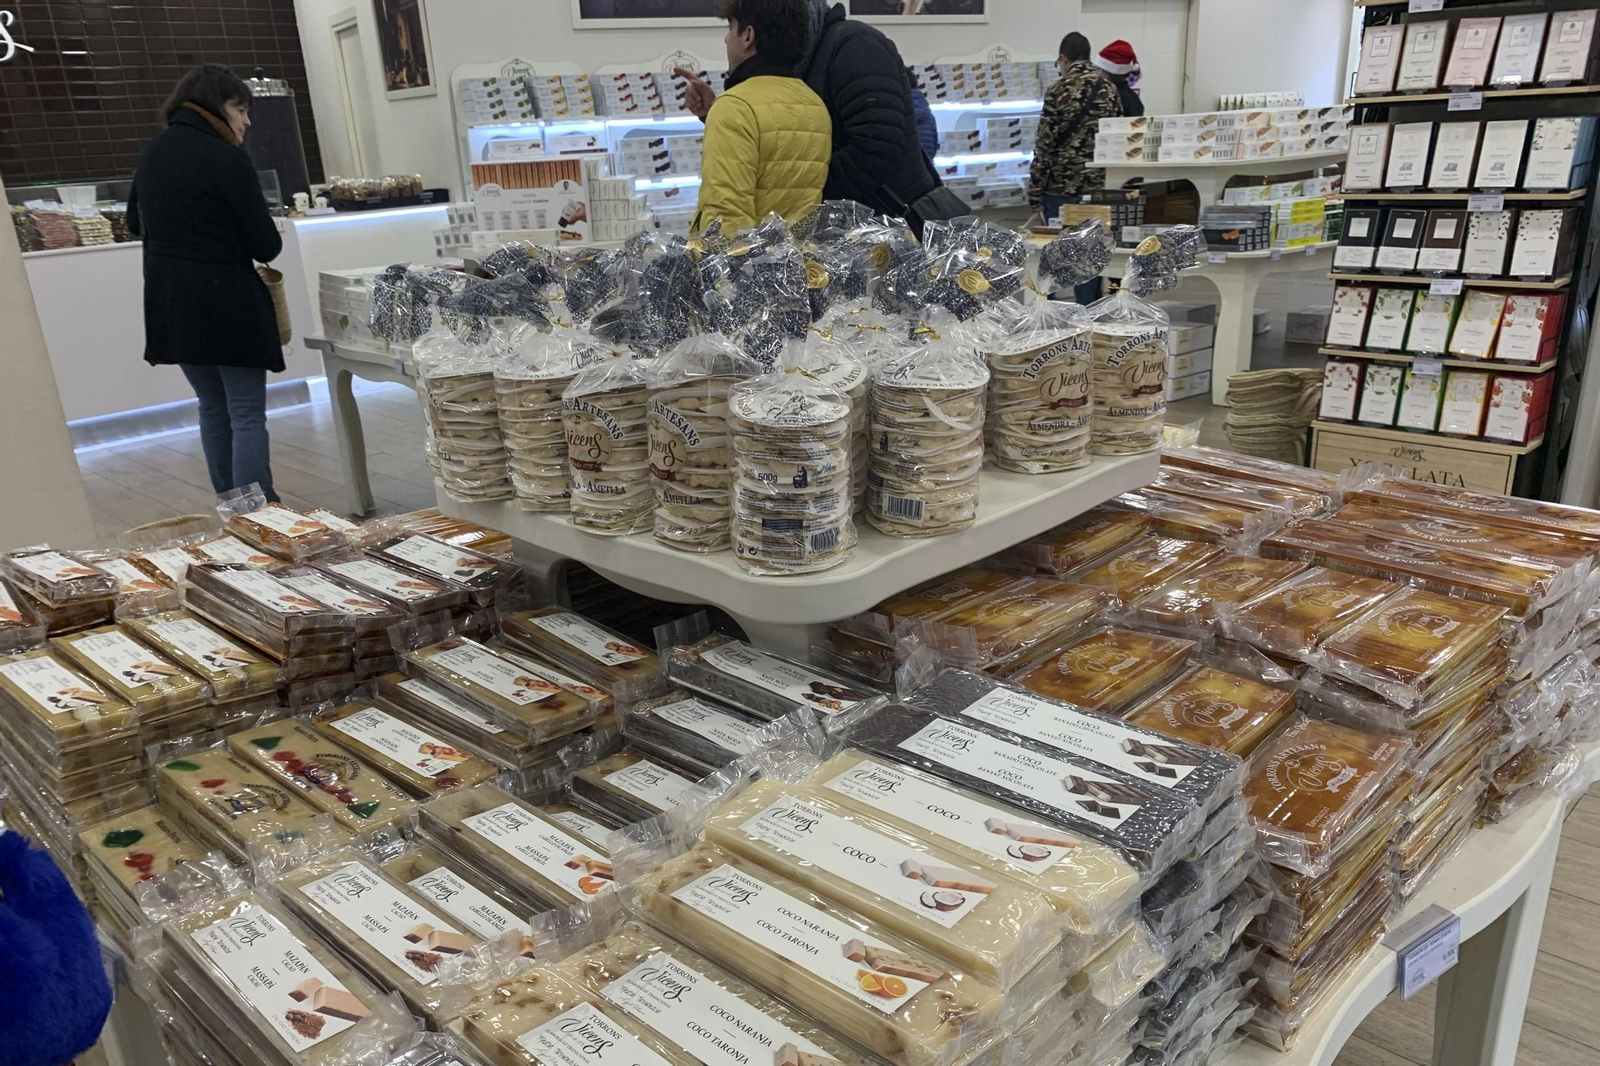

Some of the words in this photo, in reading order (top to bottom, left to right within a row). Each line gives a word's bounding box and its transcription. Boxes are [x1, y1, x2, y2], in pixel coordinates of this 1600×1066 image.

[1106, 332, 1151, 368] TORRONS
[1022, 342, 1069, 380] TORRONS
[1122, 357, 1168, 384] Vicens
[1040, 368, 1092, 398] Vicens
[573, 396, 624, 441] ARTESANS
[653, 398, 700, 447] ARTESANS
[1106, 407, 1148, 417] ALMENDRA
[1026, 420, 1070, 431] ALMENDRA
[1390, 446, 1427, 462] Vicens
[757, 472, 778, 484] 500g
[988, 696, 1036, 718] Vicens
[1007, 693, 1038, 706] TORRONS
[947, 725, 978, 739] TORRONS
[1075, 724, 1116, 740] CHOCOLATE
[1076, 719, 1101, 730] COCO
[924, 729, 975, 752] Vicens
[1058, 732, 1083, 744] COCO
[1059, 738, 1094, 753] XOCOLATA
[1016, 754, 1042, 766] COCO
[1272, 743, 1328, 762] ARTESANS
[874, 766, 905, 781] TORRONS
[997, 767, 1023, 780] COCO
[1016, 758, 1058, 776] CHOCOLATE
[1266, 760, 1287, 793] TORRONS
[1298, 756, 1342, 787] Vicens
[848, 769, 902, 794] Vicens
[999, 774, 1035, 791] XOCOLATA
[664, 796, 680, 807] NATA
[792, 802, 825, 819] TORRONS
[490, 810, 528, 831] Vicens
[766, 807, 819, 834] Vicens
[927, 804, 961, 821] COCO
[842, 845, 876, 864] COCO
[333, 873, 371, 899] Vicens
[358, 870, 379, 886] TORRONS
[443, 873, 466, 891] TORRONS
[731, 872, 764, 892] TORRONS
[419, 877, 459, 903] Vicens
[702, 876, 758, 905] Vicens
[391, 900, 420, 921] MAZAPÁN
[479, 905, 509, 926] MAZAPÁN
[229, 917, 267, 946] Vicens
[256, 914, 276, 933] TORRONS
[777, 906, 802, 923] COCO
[800, 918, 840, 942] NARANJA
[756, 918, 781, 936] COCO
[780, 931, 819, 956] TARONJA
[284, 949, 311, 974] MAZAPÁN
[665, 961, 699, 984] TORRONS
[636, 967, 692, 1003] Vicens
[589, 1013, 623, 1040] TORRONS
[709, 1004, 735, 1025] COCO
[733, 1020, 773, 1048] NARANJA
[557, 1017, 614, 1059] Vicens
[686, 1020, 712, 1041] COCO
[711, 1036, 749, 1066] TARONJA
